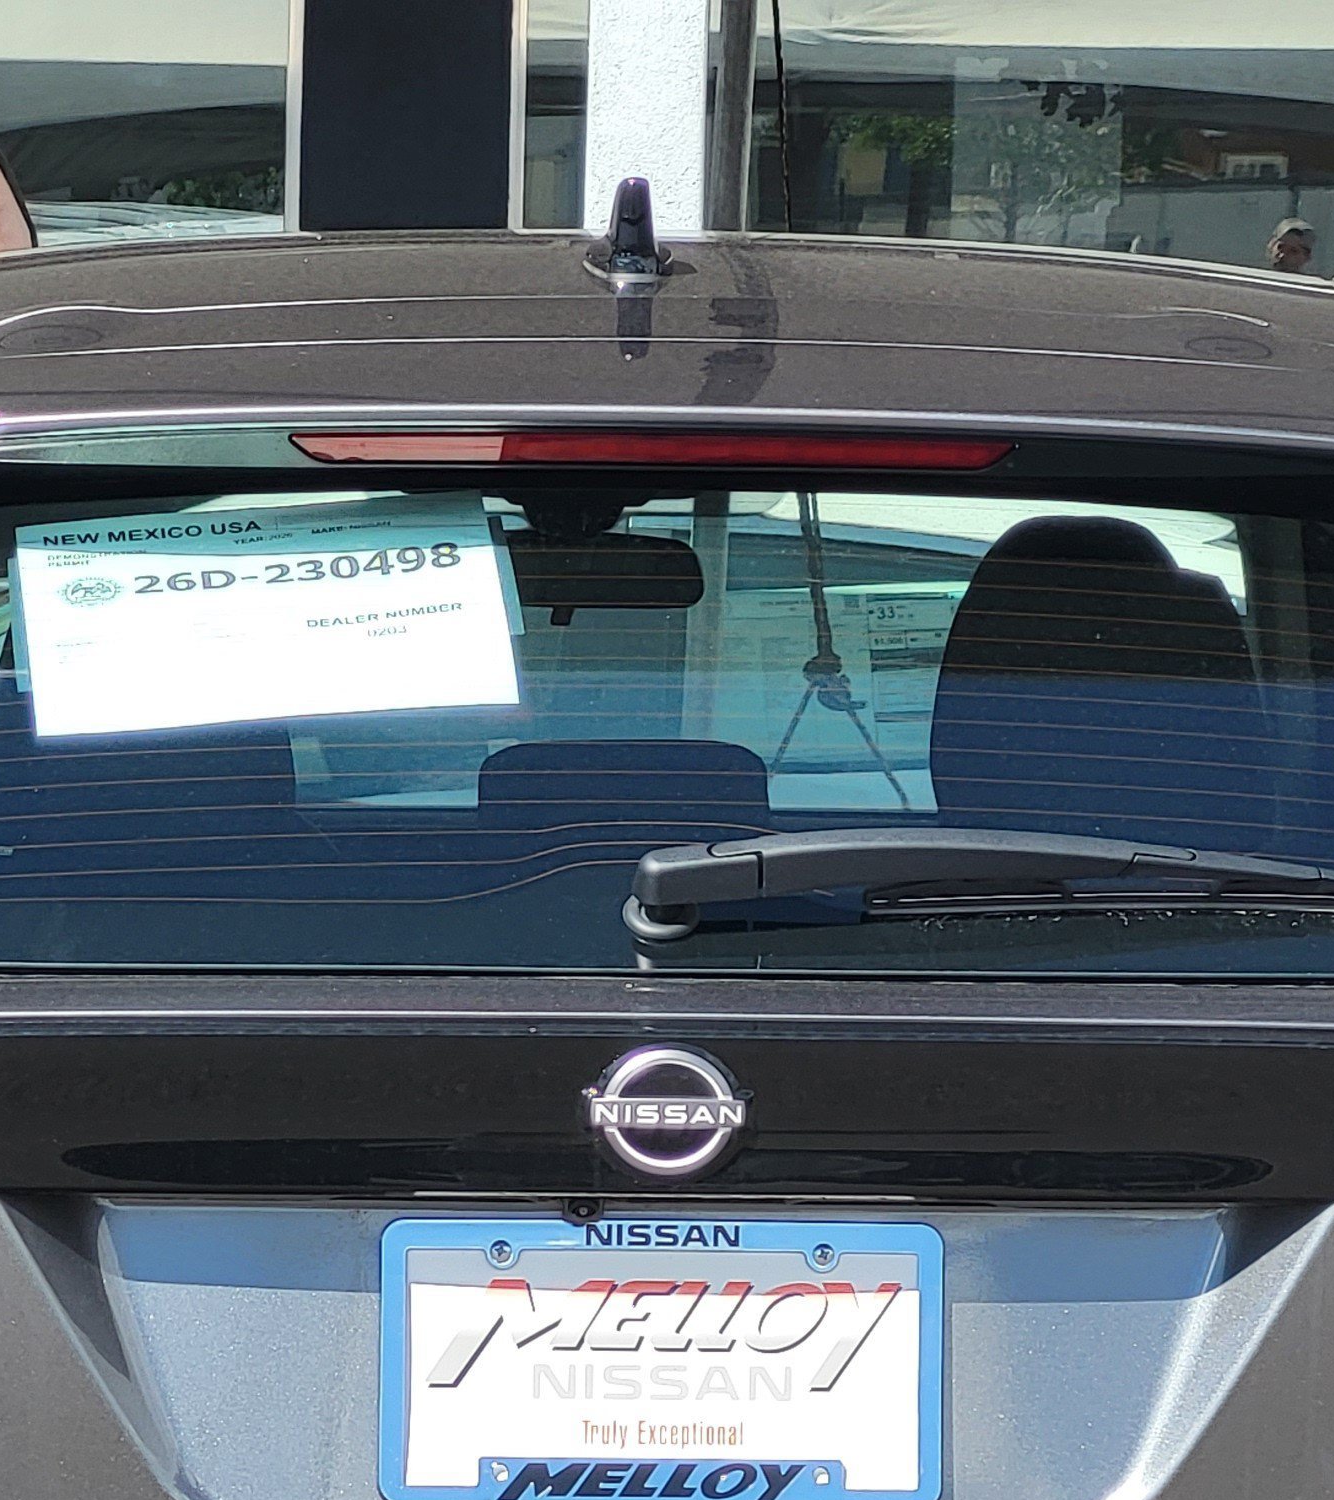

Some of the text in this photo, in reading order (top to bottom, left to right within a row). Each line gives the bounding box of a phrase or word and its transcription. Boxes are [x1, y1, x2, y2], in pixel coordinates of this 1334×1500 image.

[43, 520, 262, 546] NEW MEXICO USA
[134, 541, 462, 594] 26D-230498
[306, 602, 463, 628] DEALER NUMBER
[595, 1104, 743, 1125] NISSAN
[585, 1223, 741, 1248] NISSAN
[428, 1279, 903, 1392] MELLOY
[532, 1363, 792, 1401] NISSAN
[582, 1420, 744, 1449] Truly Exceptional
